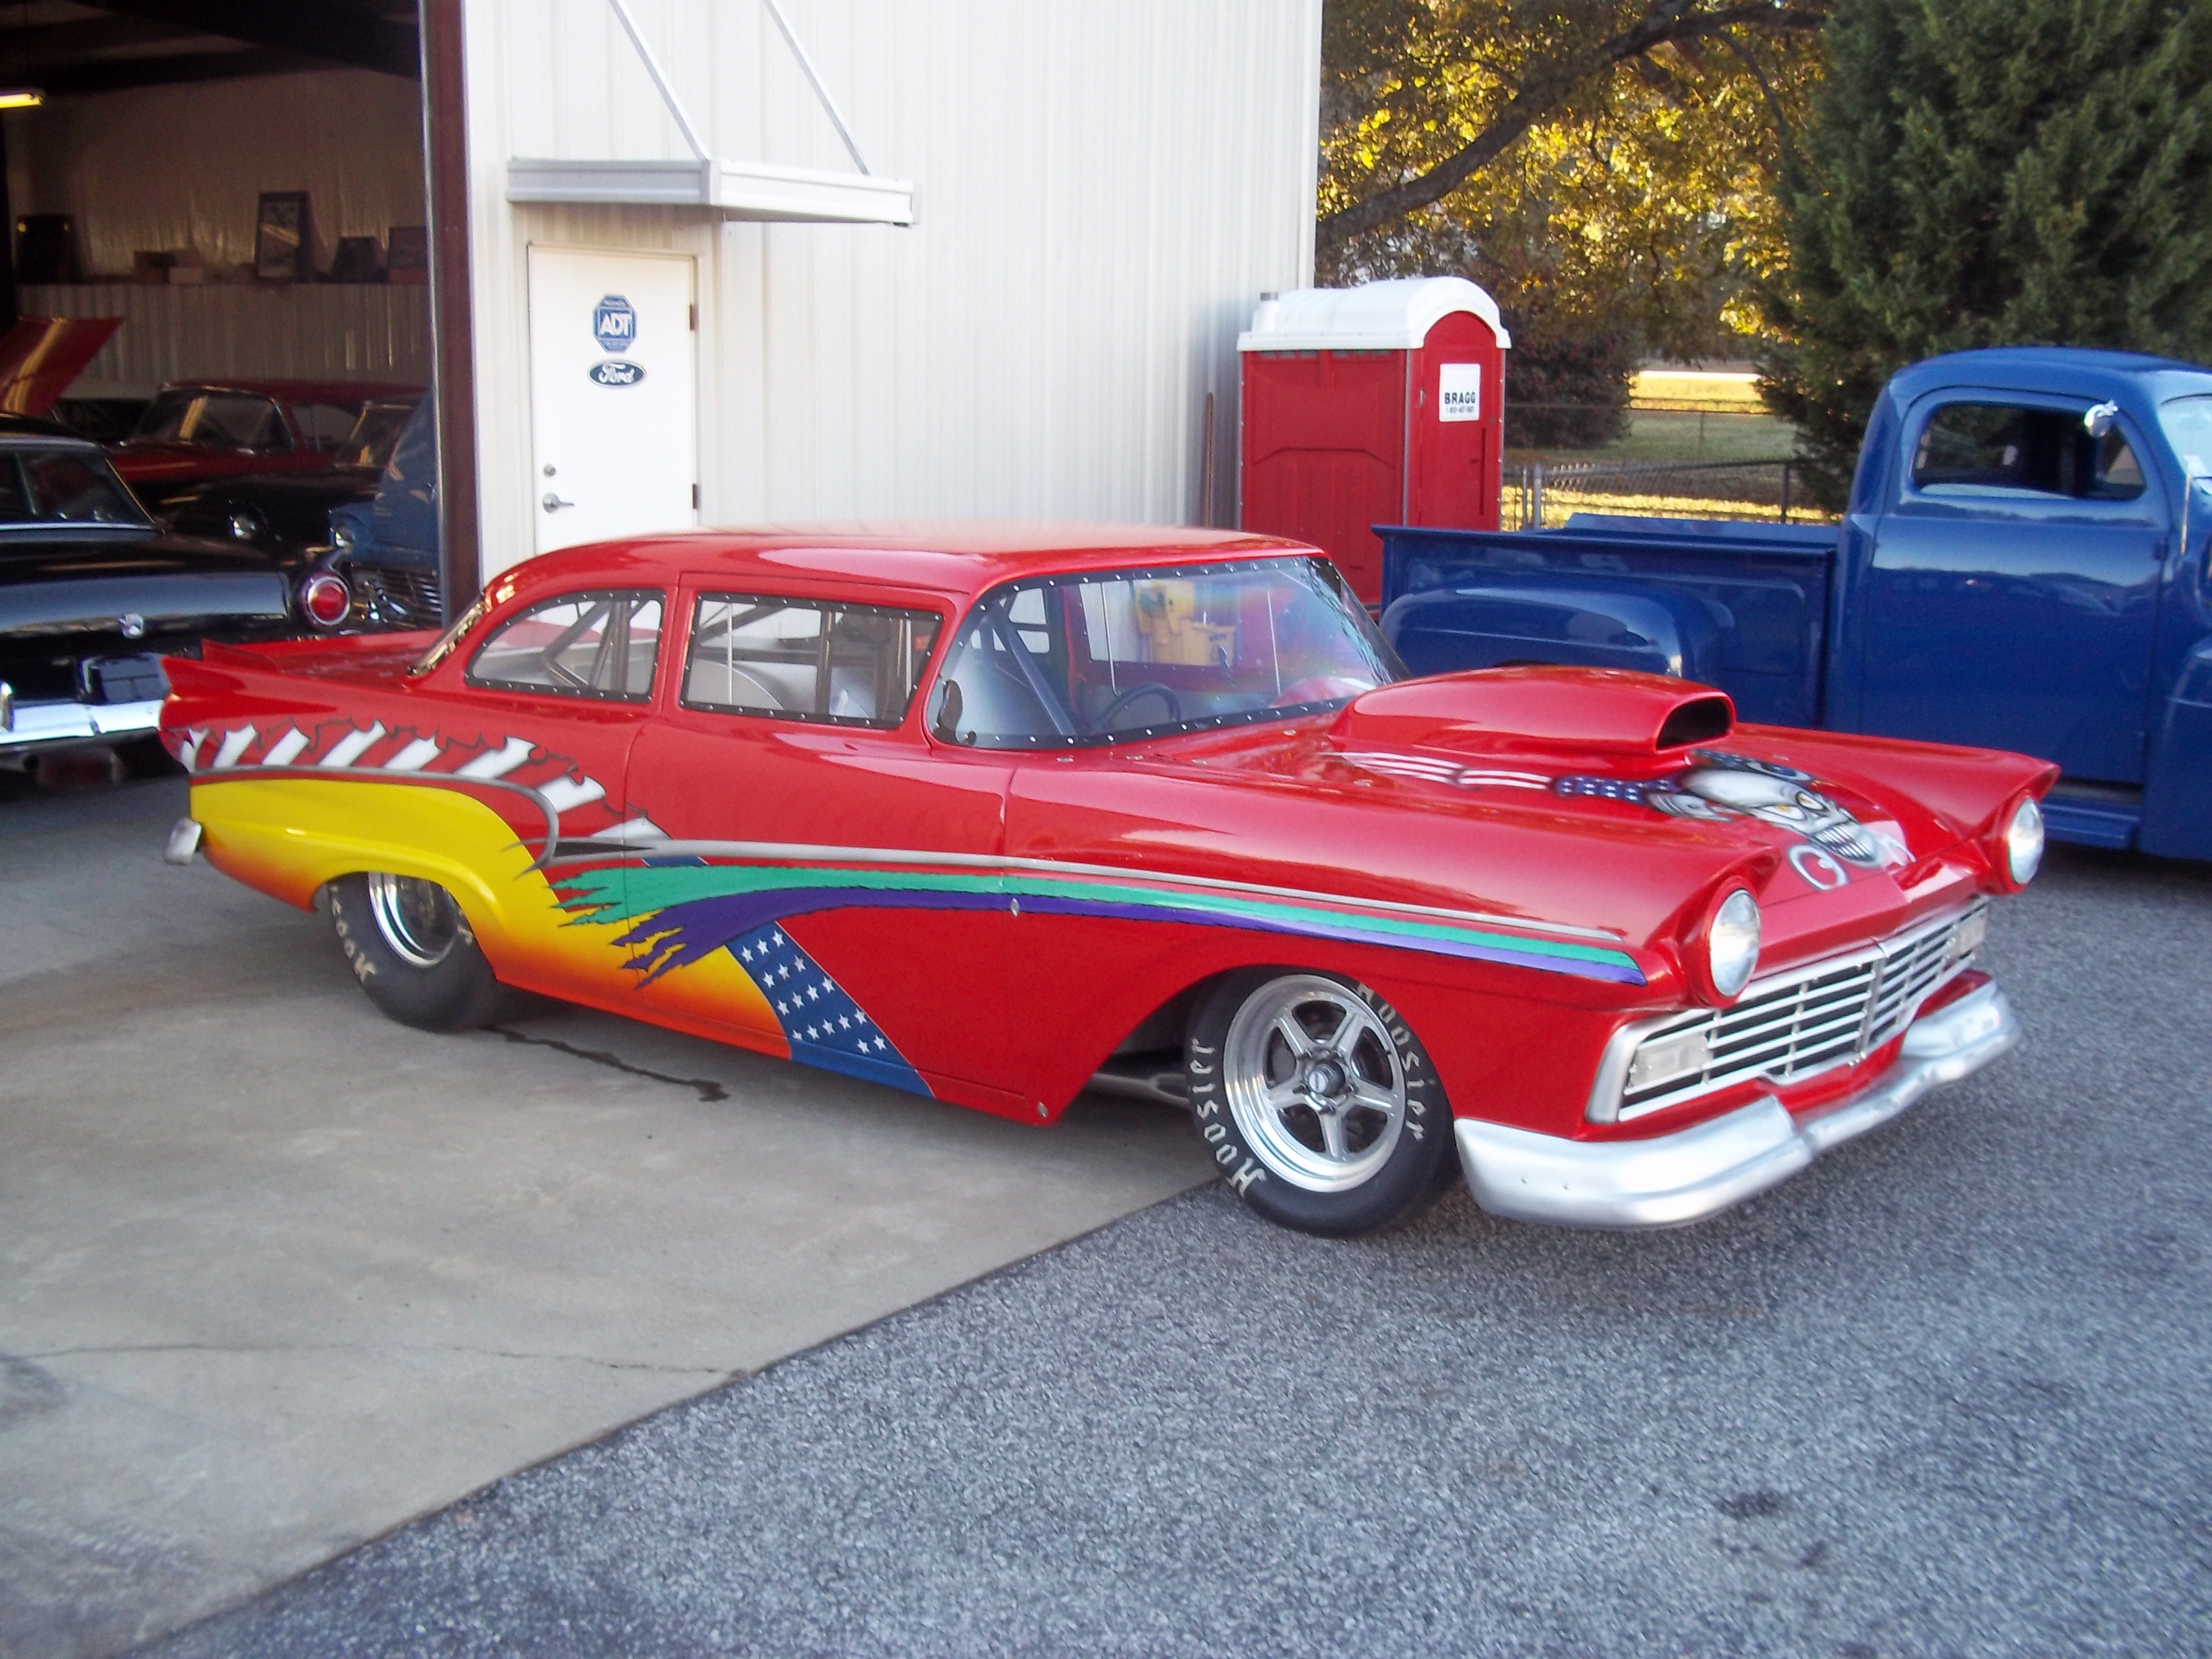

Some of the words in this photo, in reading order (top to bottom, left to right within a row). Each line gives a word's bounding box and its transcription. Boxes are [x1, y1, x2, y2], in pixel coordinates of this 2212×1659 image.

[599, 312, 632, 336] ADT
[598, 362, 635, 384] Ford
[1444, 392, 1475, 404] BRAGG
[1188, 1037, 1267, 1198] Hoosier
